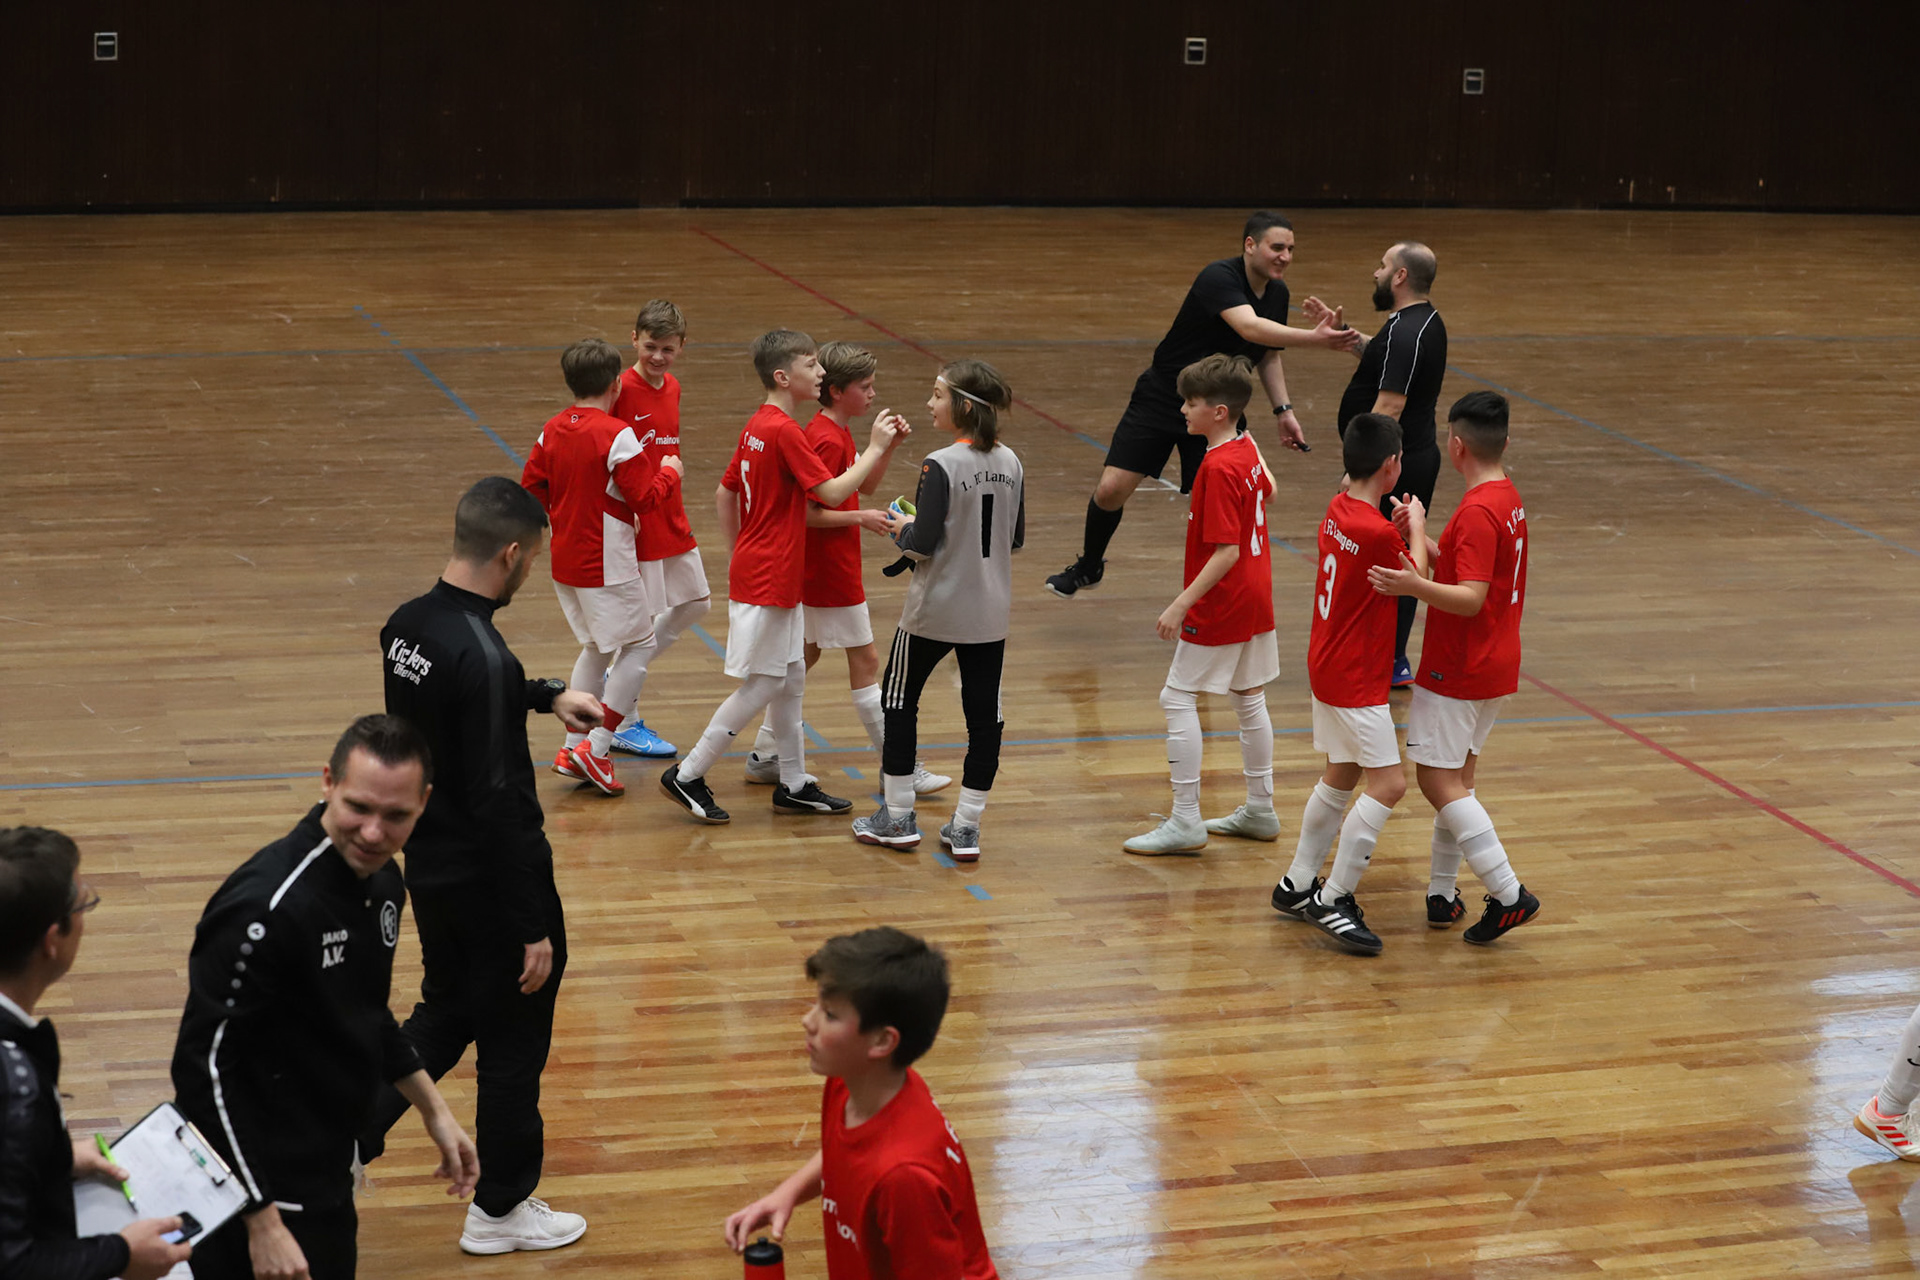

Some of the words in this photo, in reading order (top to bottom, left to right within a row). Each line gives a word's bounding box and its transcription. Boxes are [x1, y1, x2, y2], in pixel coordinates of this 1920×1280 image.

[960, 480, 972, 492] 1.
[981, 493, 994, 559] 1
[1318, 552, 1337, 621] 3
[387, 637, 432, 676] Kickers
[322, 929, 348, 946] JAKO
